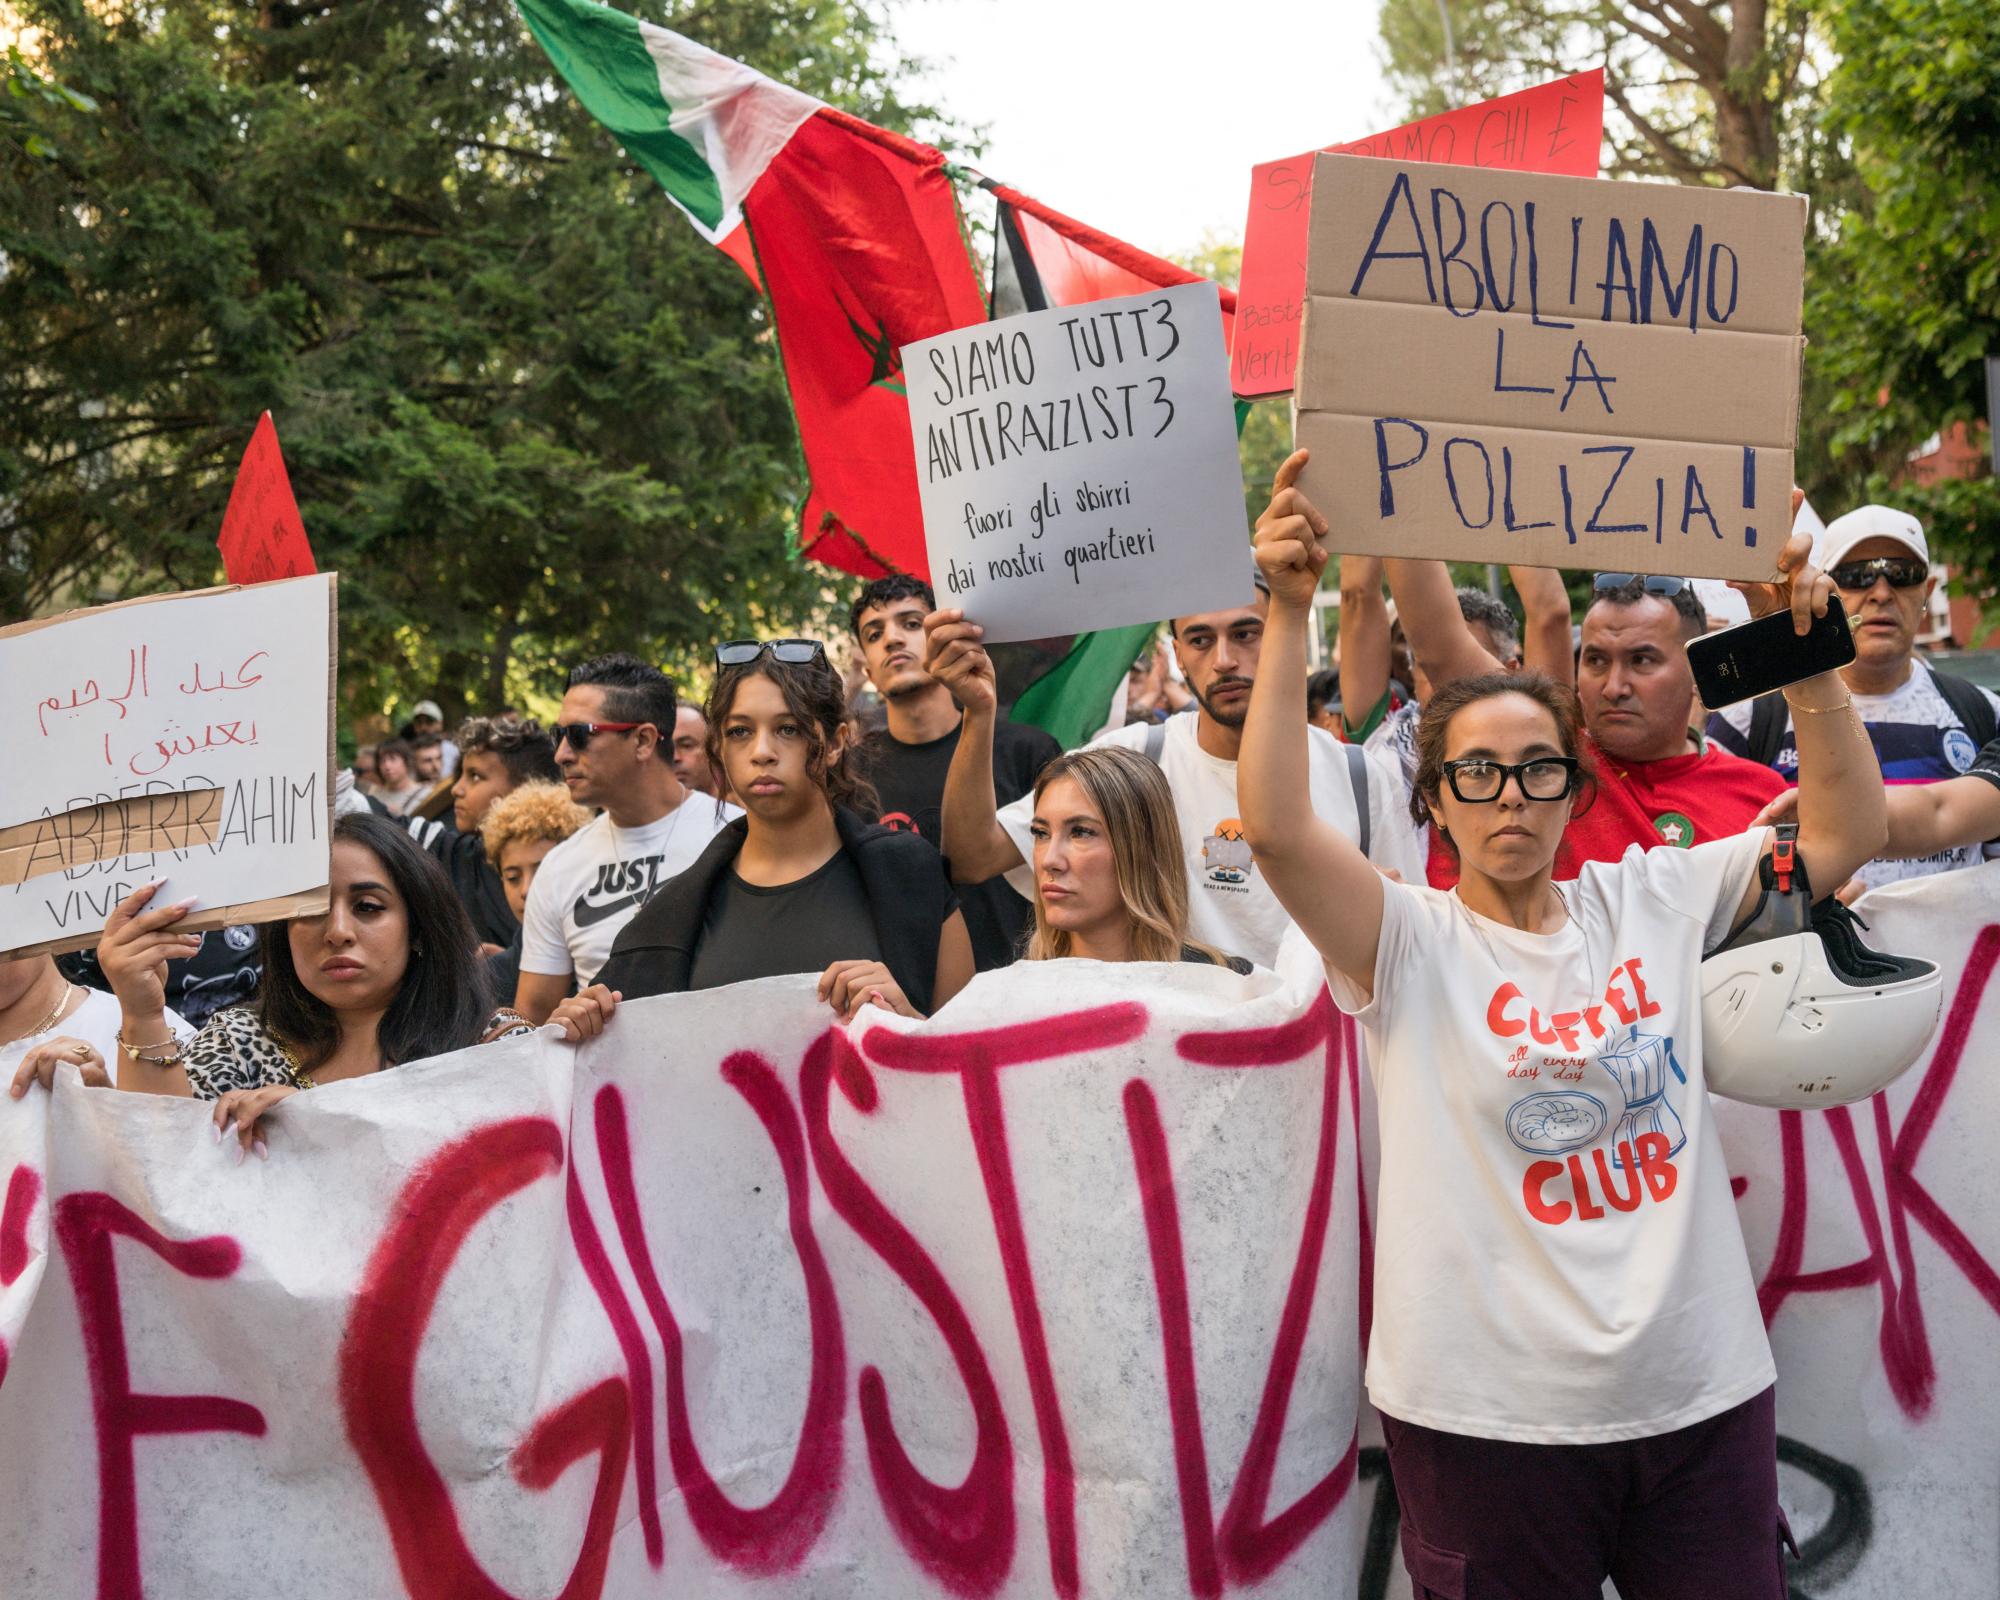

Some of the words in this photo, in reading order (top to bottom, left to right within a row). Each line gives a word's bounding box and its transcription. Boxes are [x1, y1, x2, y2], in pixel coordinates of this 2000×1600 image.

[1474, 106, 1530, 167] CHI
[1351, 172, 1739, 333] ABOLIAMO
[929, 331, 1035, 406] SIAMO
[1059, 299, 1180, 372] TUTT3
[1239, 337, 1294, 382] Verit
[1494, 328, 1616, 414] LA
[928, 376, 1175, 483] ANTIRAZZIST3
[963, 502, 1013, 539] fuori
[1030, 482, 1061, 539] gli
[1076, 480, 1131, 513] sbirri
[1373, 417, 1757, 547] POLIZIA!
[947, 559, 976, 595] dai
[988, 543, 1044, 582] nostri
[1064, 527, 1155, 585] quartieri
[180, 651, 269, 701] عبد
[15, 772, 317, 894] ABDERRAHIM
[587, 854, 665, 897] JUST
[1507, 1063, 1541, 1080] day
[1508, 1045, 1529, 1062] all
[1543, 1056, 1589, 1069] every
[1553, 1067, 1585, 1082] day
[1522, 1132, 1677, 1225] CLUB
